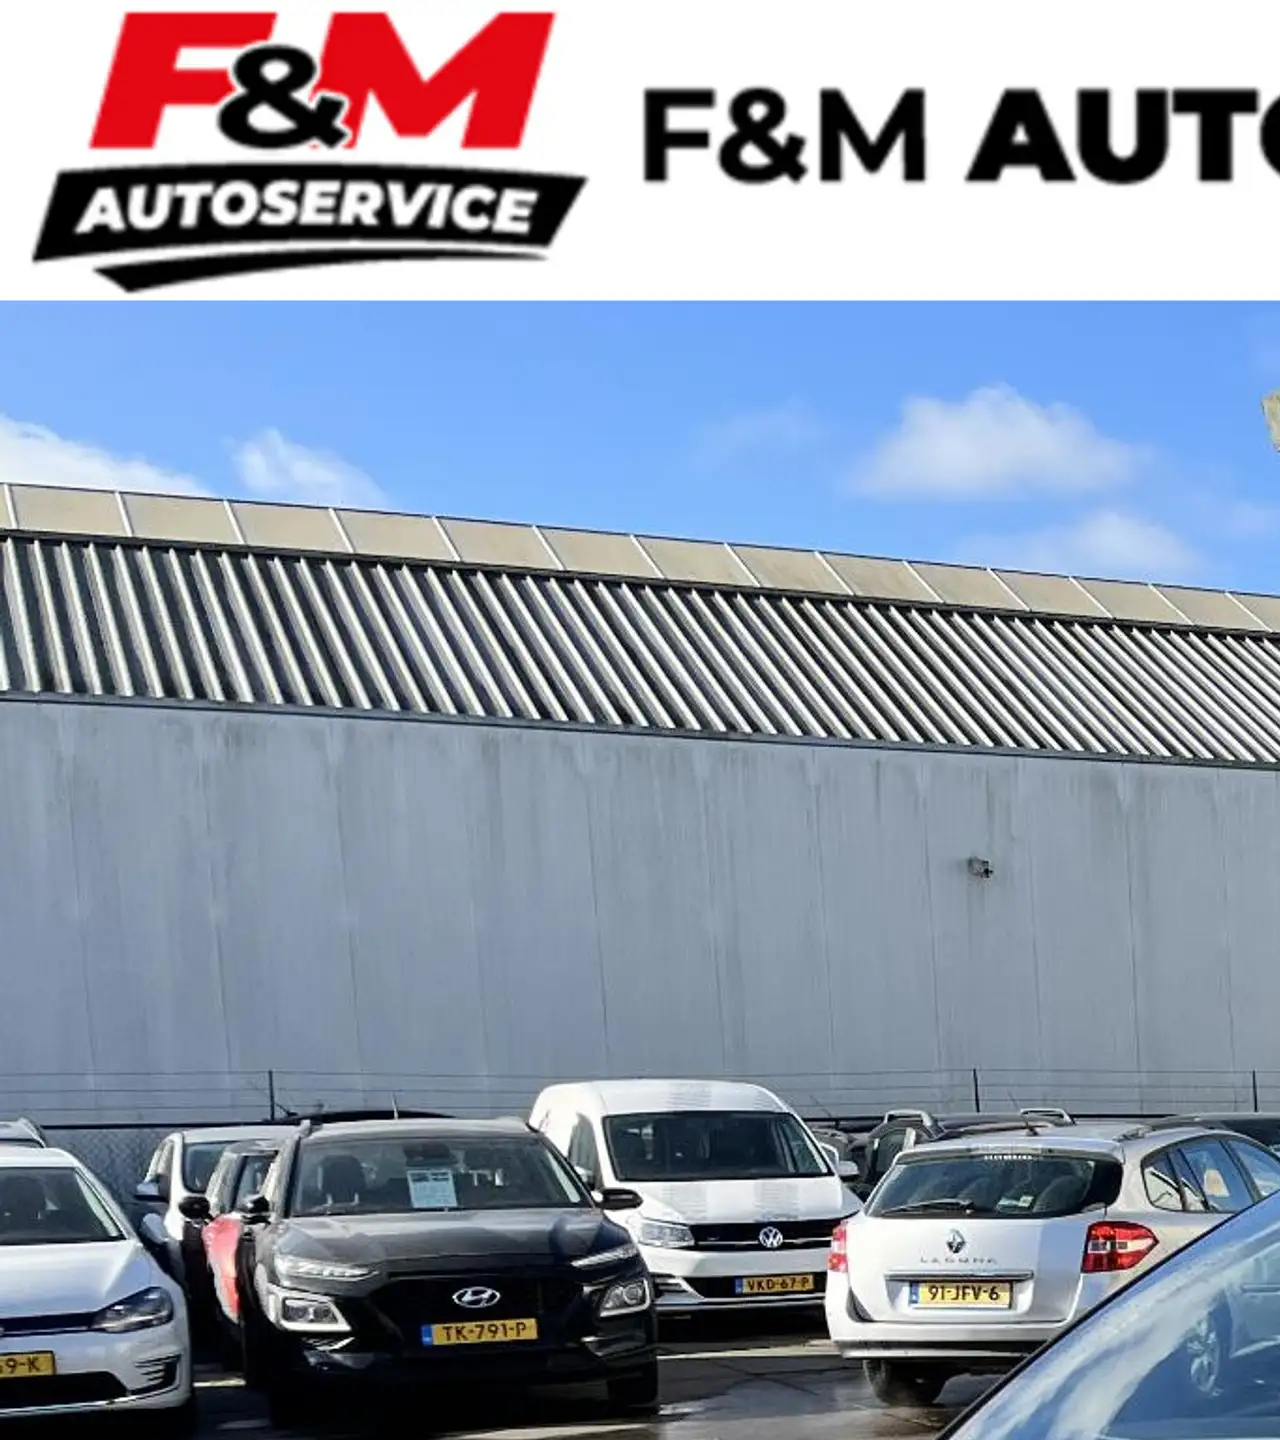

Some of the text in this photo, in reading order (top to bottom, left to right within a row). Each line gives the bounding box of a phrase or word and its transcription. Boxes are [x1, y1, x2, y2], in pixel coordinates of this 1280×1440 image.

[927, 1285, 1001, 1301] 91-JFV-6
[442, 1321, 527, 1341] TK-791-P
[0, 1355, 41, 1374] 9-K
